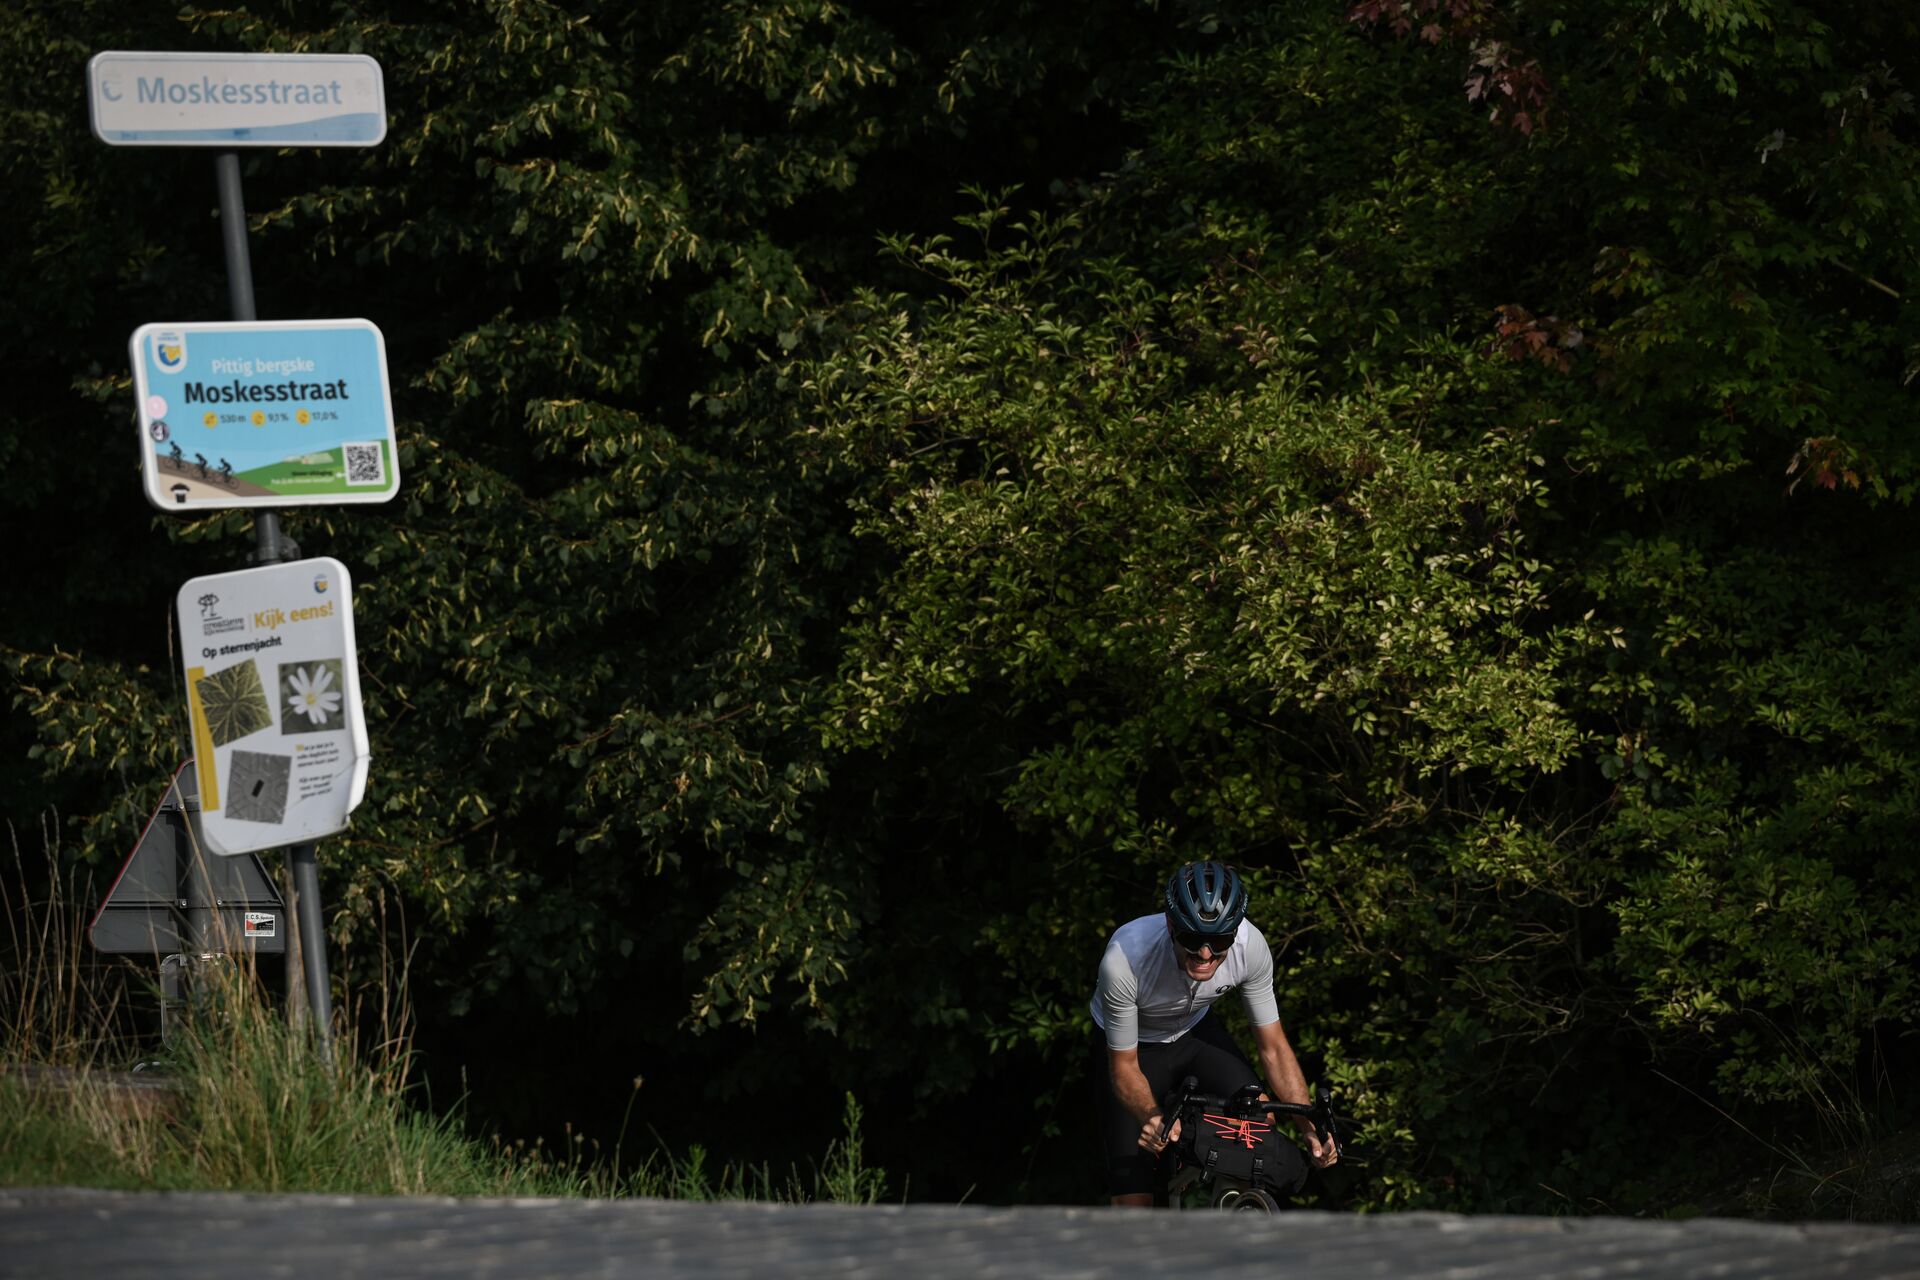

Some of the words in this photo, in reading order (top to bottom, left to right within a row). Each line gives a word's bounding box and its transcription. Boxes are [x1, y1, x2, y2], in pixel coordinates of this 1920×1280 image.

[137, 76, 343, 105] Moskesstraat
[212, 358, 254, 376] Pittig
[256, 357, 316, 375] bergske
[184, 379, 349, 403] Moskesstraat
[254, 608, 286, 630] Kijk
[290, 601, 333, 622] eens!
[202, 647, 217, 659] Op
[220, 636, 282, 655] sterrenjacht
